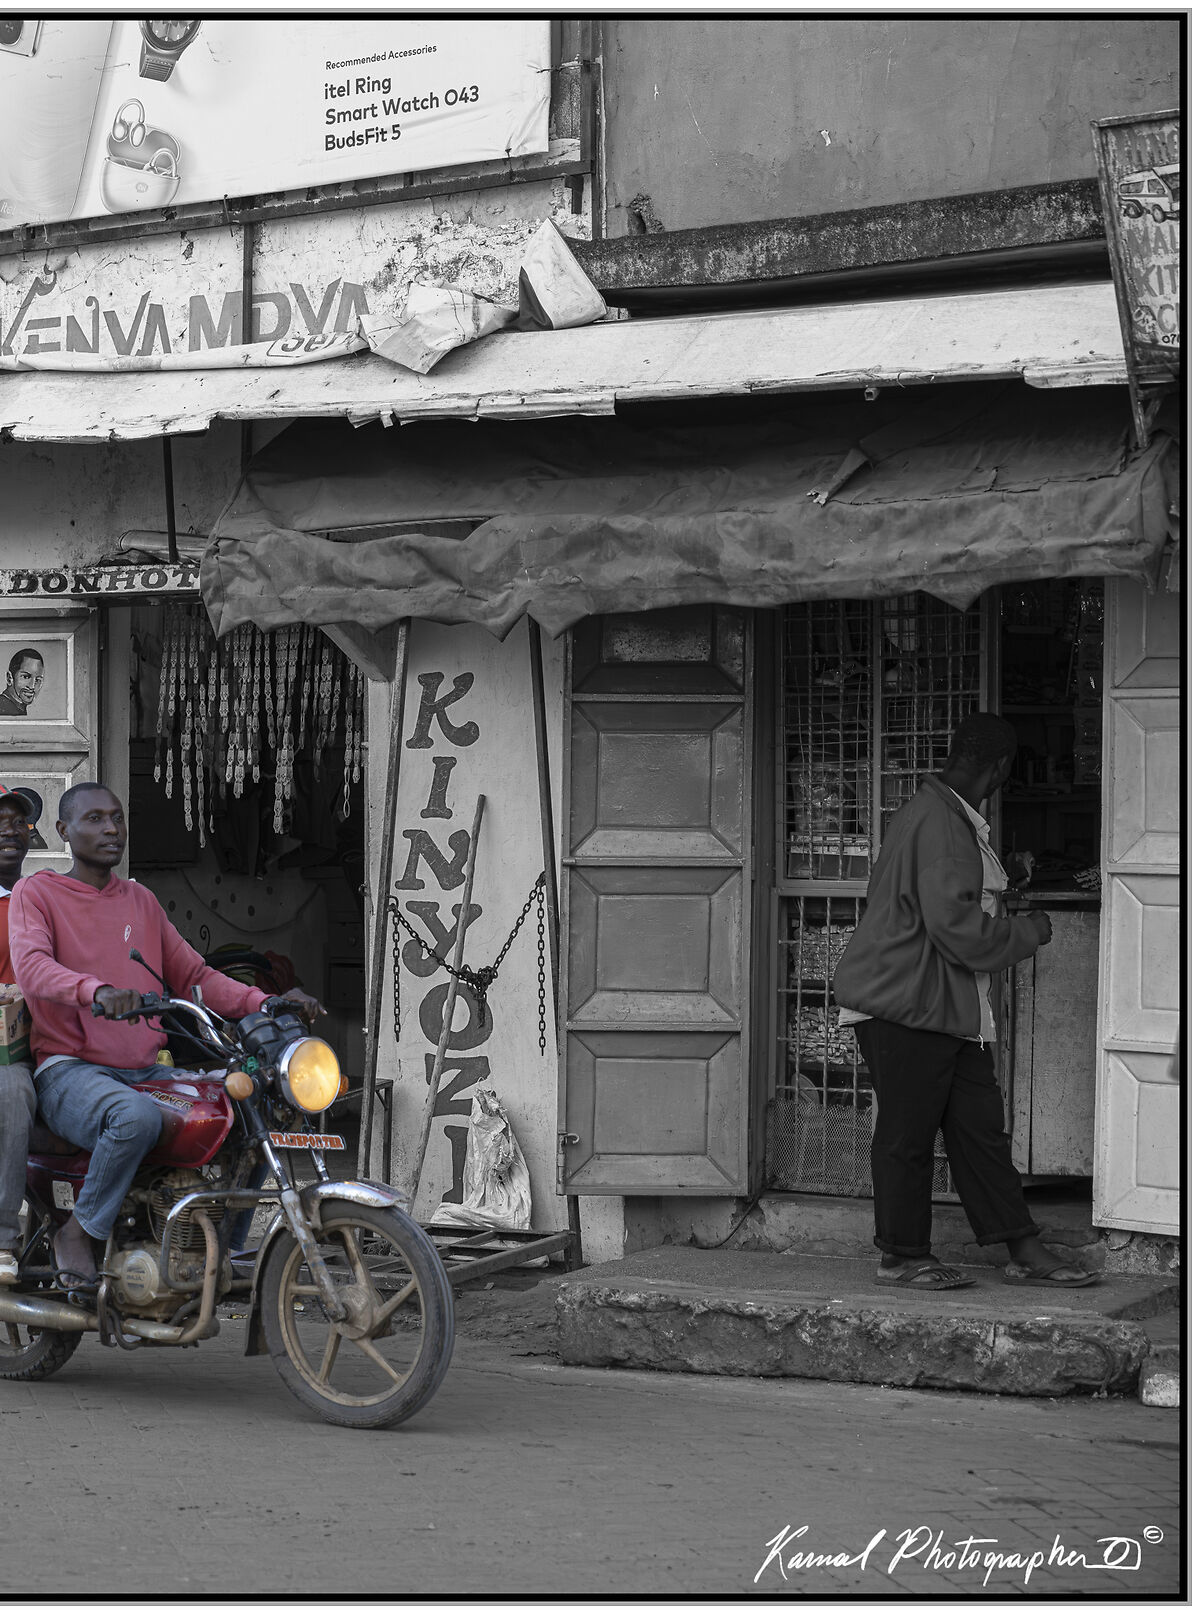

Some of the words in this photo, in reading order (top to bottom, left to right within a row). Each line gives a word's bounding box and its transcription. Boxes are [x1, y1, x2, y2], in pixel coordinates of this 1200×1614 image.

[325, 52, 387, 70] Recommended
[388, 44, 437, 60] Accessories
[324, 79, 350, 100] itel
[355, 75, 392, 95] Ring
[325, 103, 378, 125] Smart
[382, 92, 439, 116] Watch
[325, 126, 388, 151] BudsFit
[391, 124, 401, 141] 5
[268, 1132, 345, 1150] TRANSPORTER
